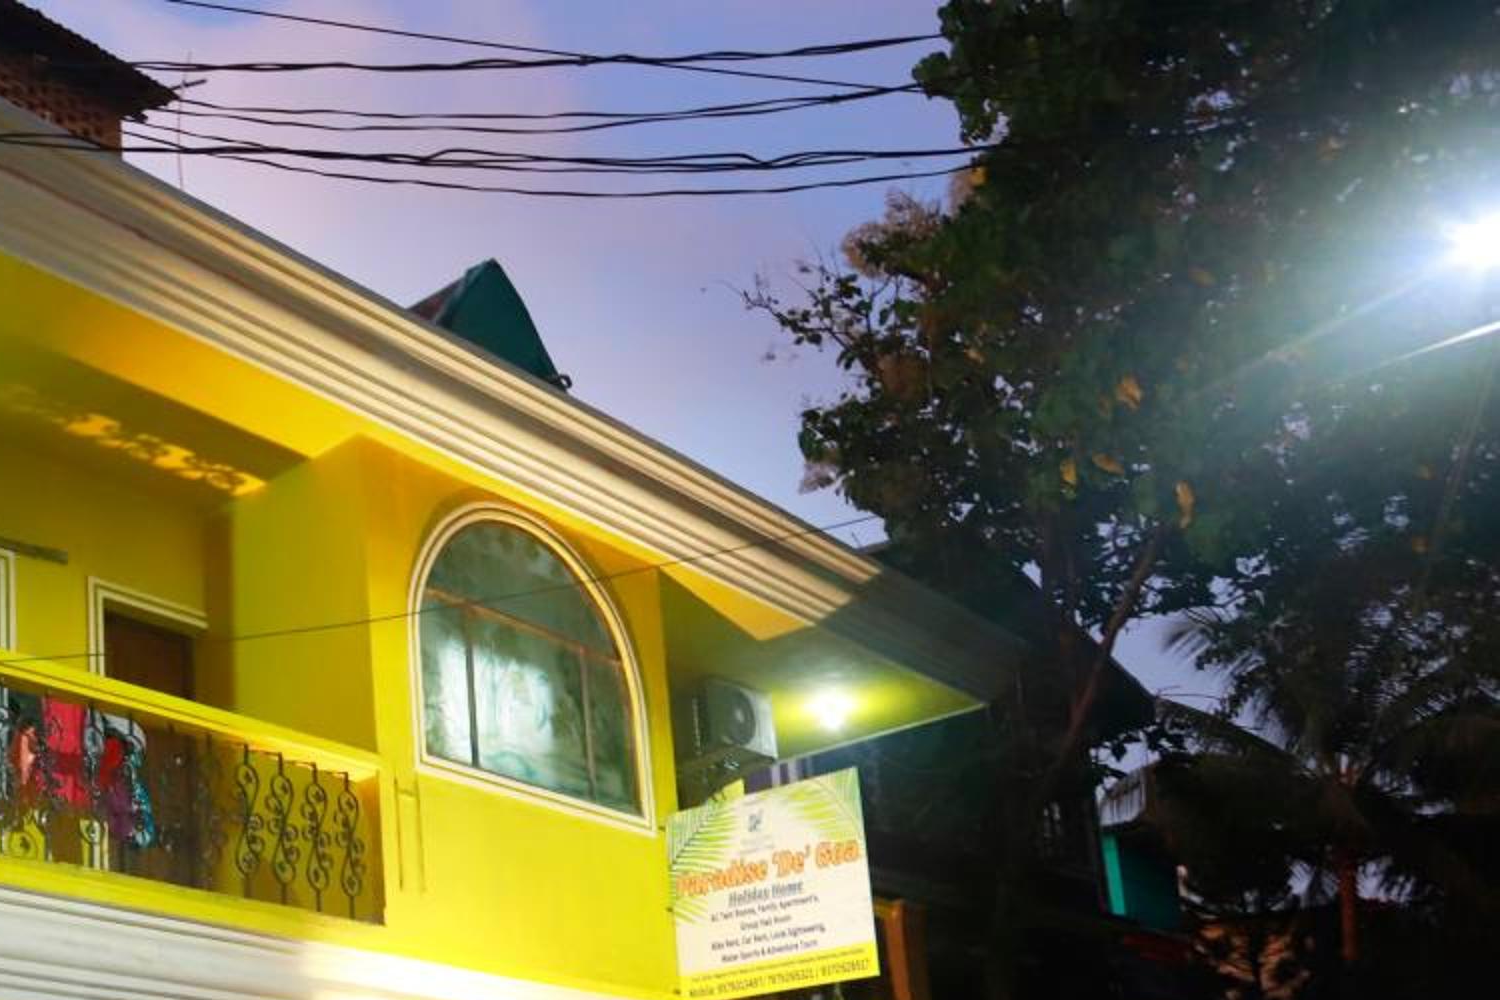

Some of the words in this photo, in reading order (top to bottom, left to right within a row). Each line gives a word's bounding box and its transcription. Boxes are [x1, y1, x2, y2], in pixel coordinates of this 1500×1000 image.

[815, 840, 860, 868] Goa
[728, 886, 768, 905] Holiday
[771, 881, 803, 898] Home
